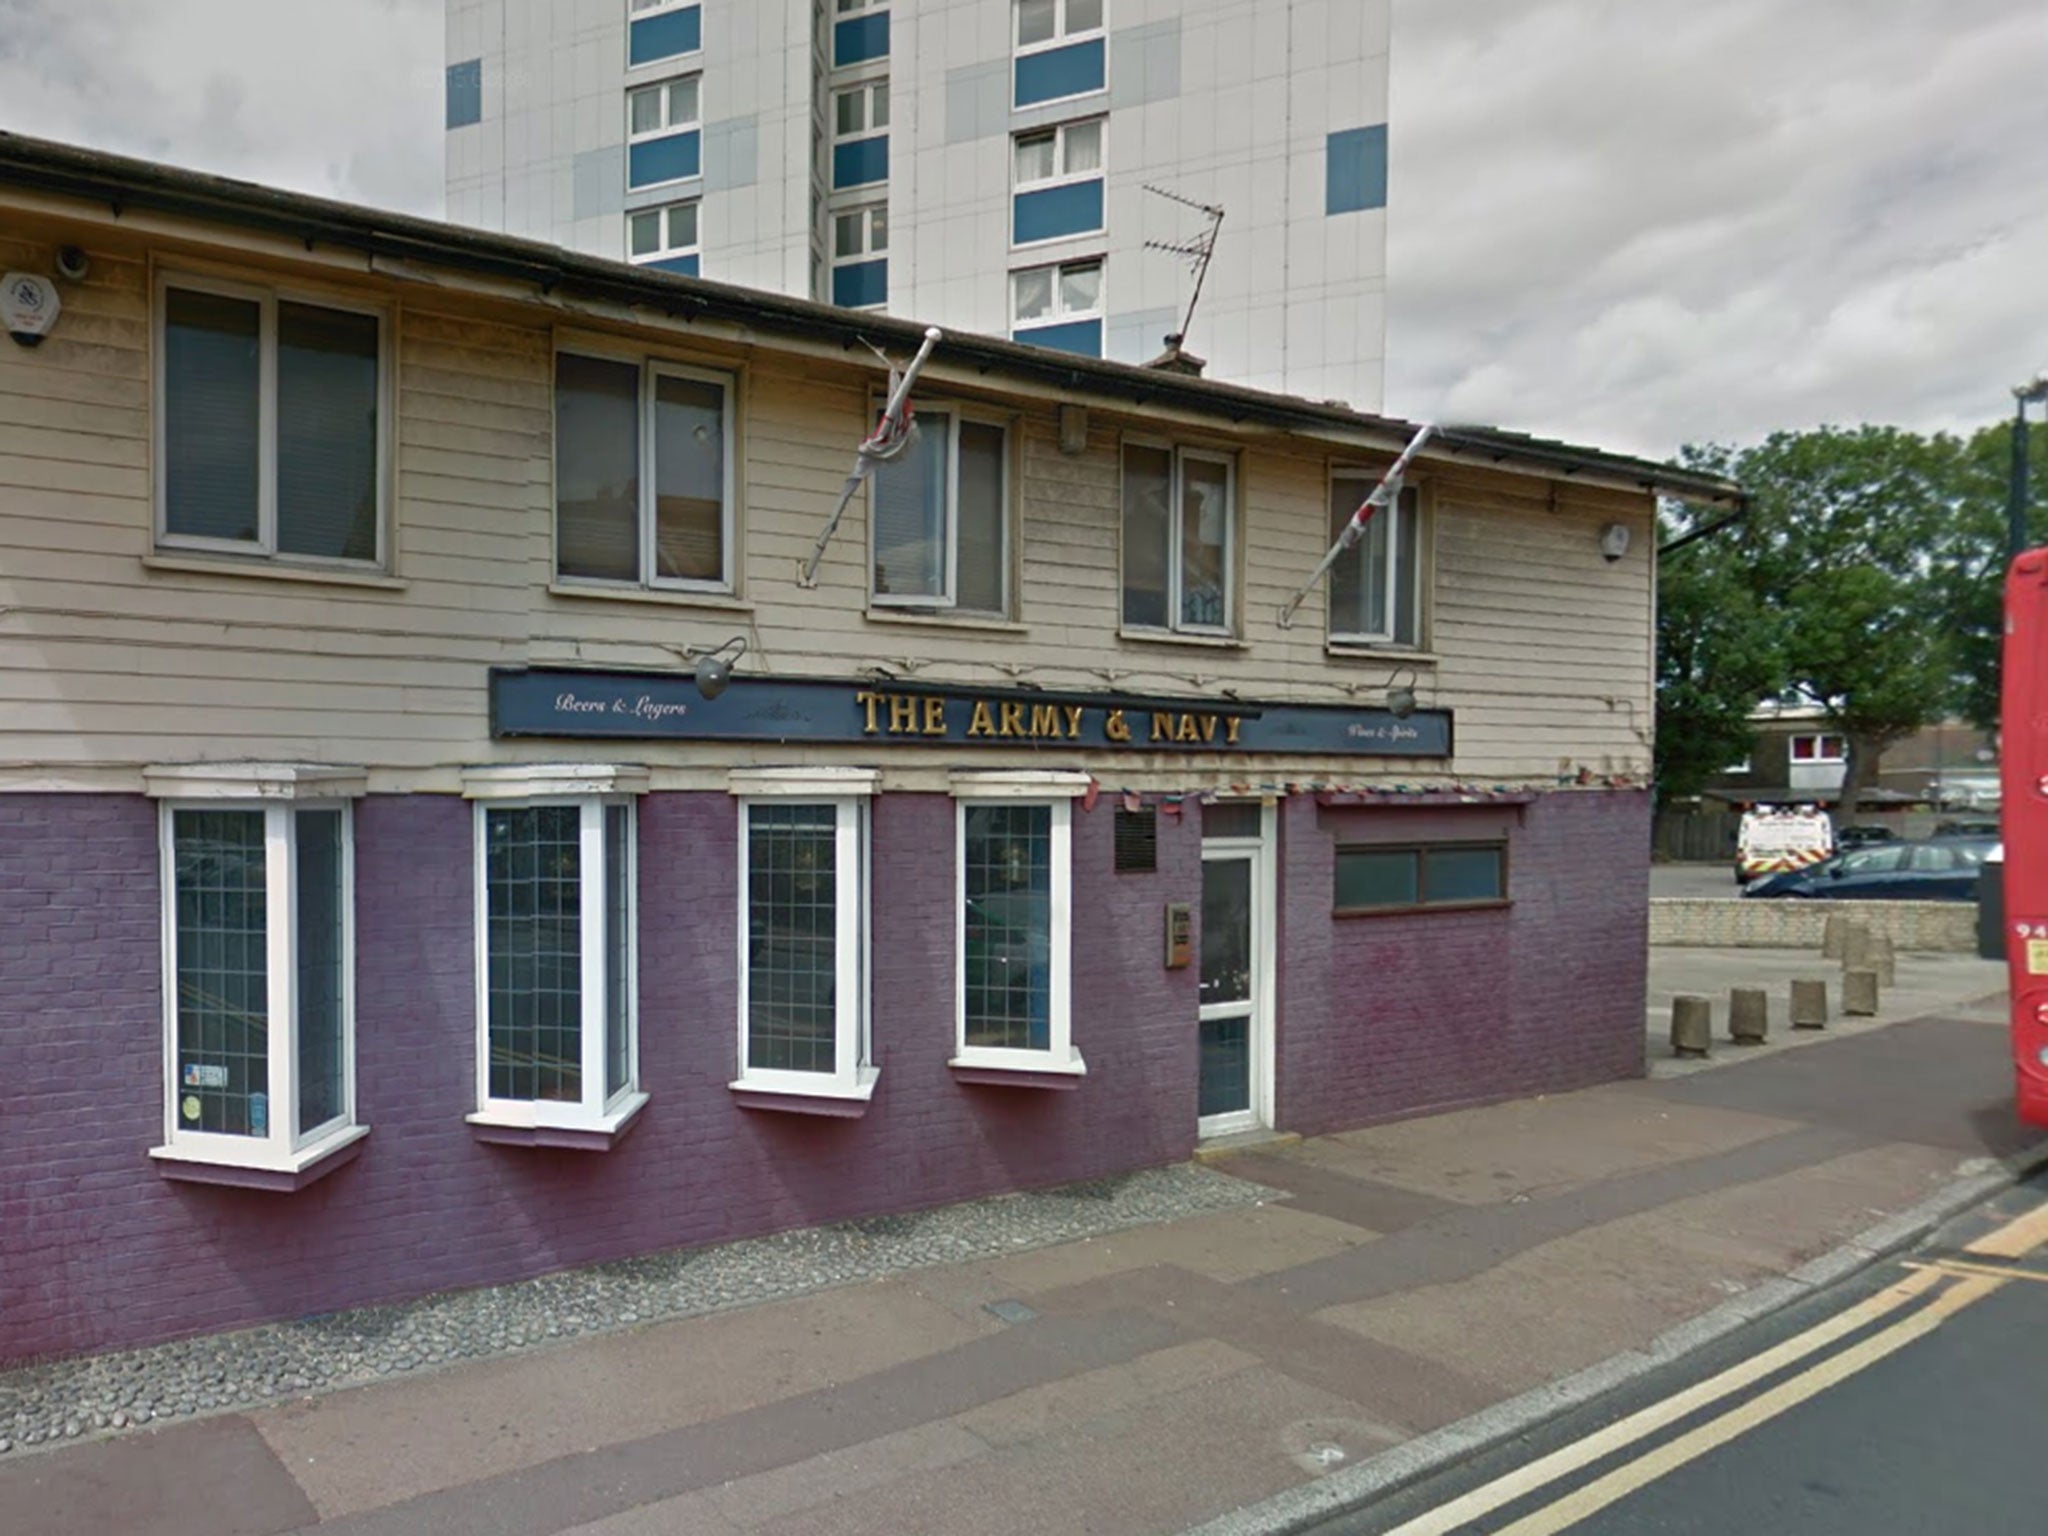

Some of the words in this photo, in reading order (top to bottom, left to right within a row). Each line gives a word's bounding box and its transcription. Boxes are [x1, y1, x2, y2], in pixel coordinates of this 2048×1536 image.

[554, 693, 606, 712] Beers
[612, 698, 627, 712] &
[629, 695, 686, 720] Lagers
[856, 691, 948, 734] THE
[966, 700, 1083, 738] ARMY
[1106, 708, 1132, 741] &
[1151, 712, 1240, 743] NAVY
